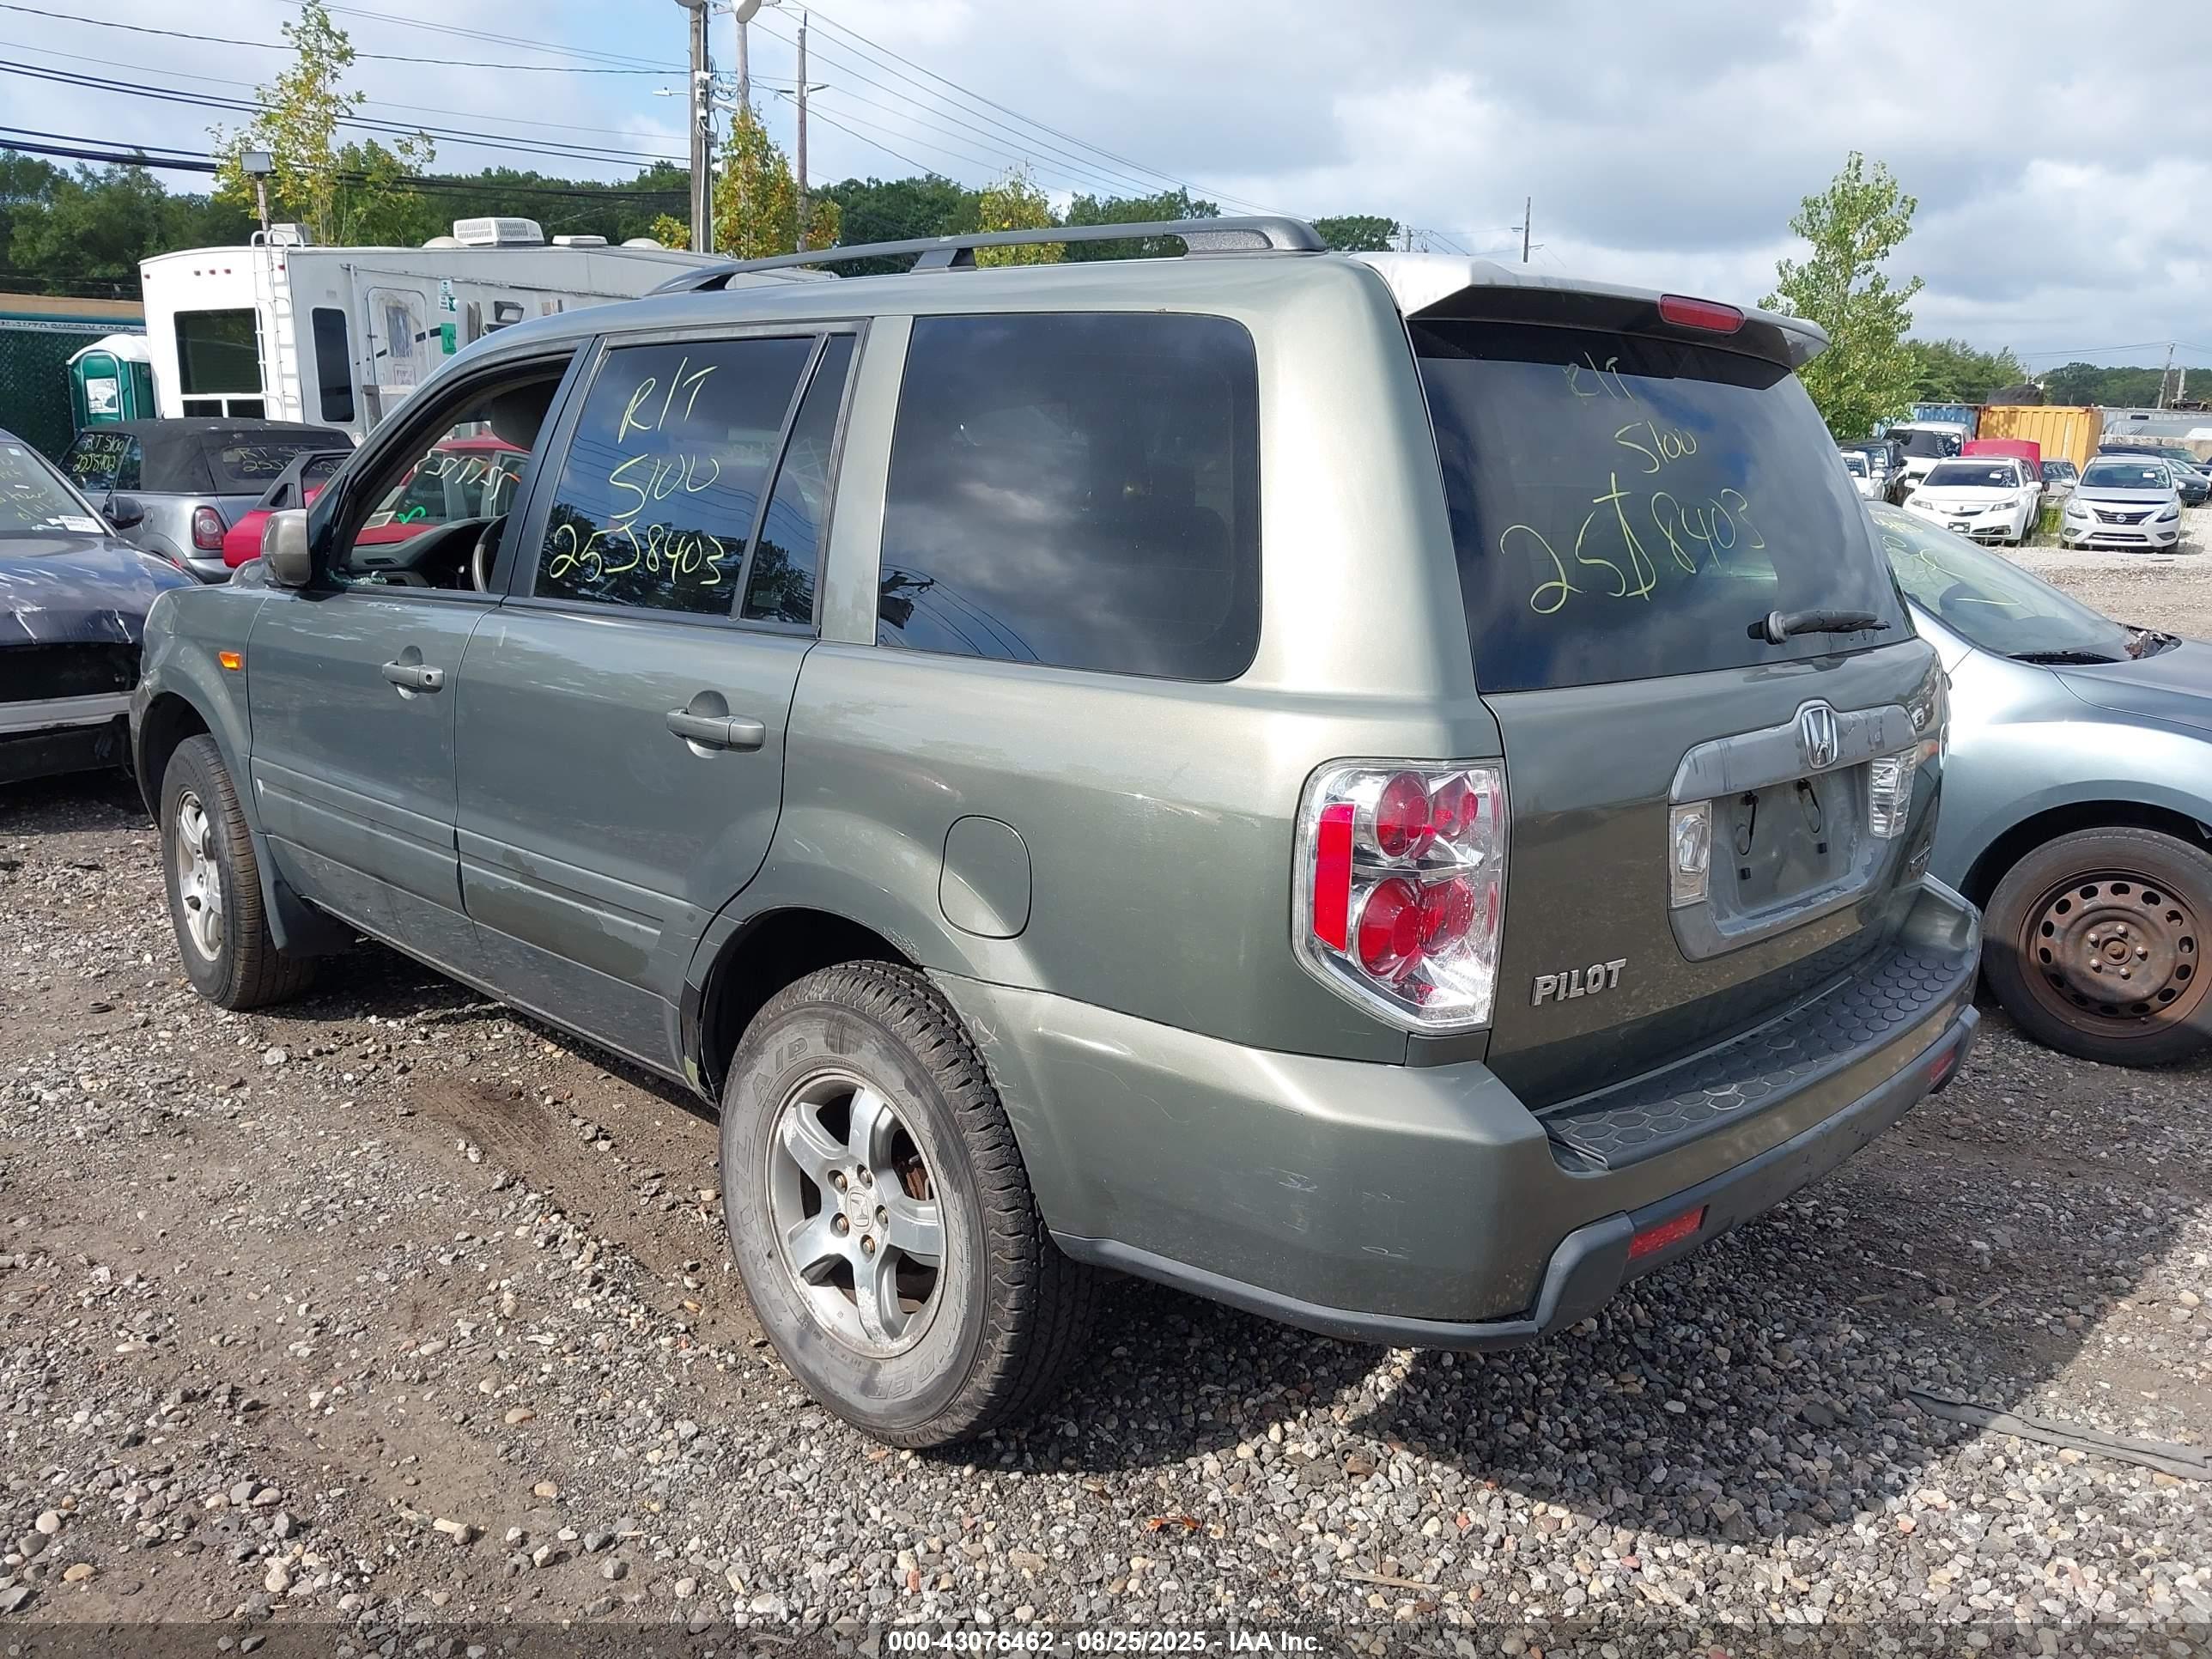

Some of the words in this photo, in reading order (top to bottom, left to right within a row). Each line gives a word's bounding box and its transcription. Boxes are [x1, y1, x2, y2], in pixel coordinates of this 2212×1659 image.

[618, 356, 719, 445] R/T
[1613, 419, 1697, 475] S100
[1531, 958, 1627, 1006] PILOT
